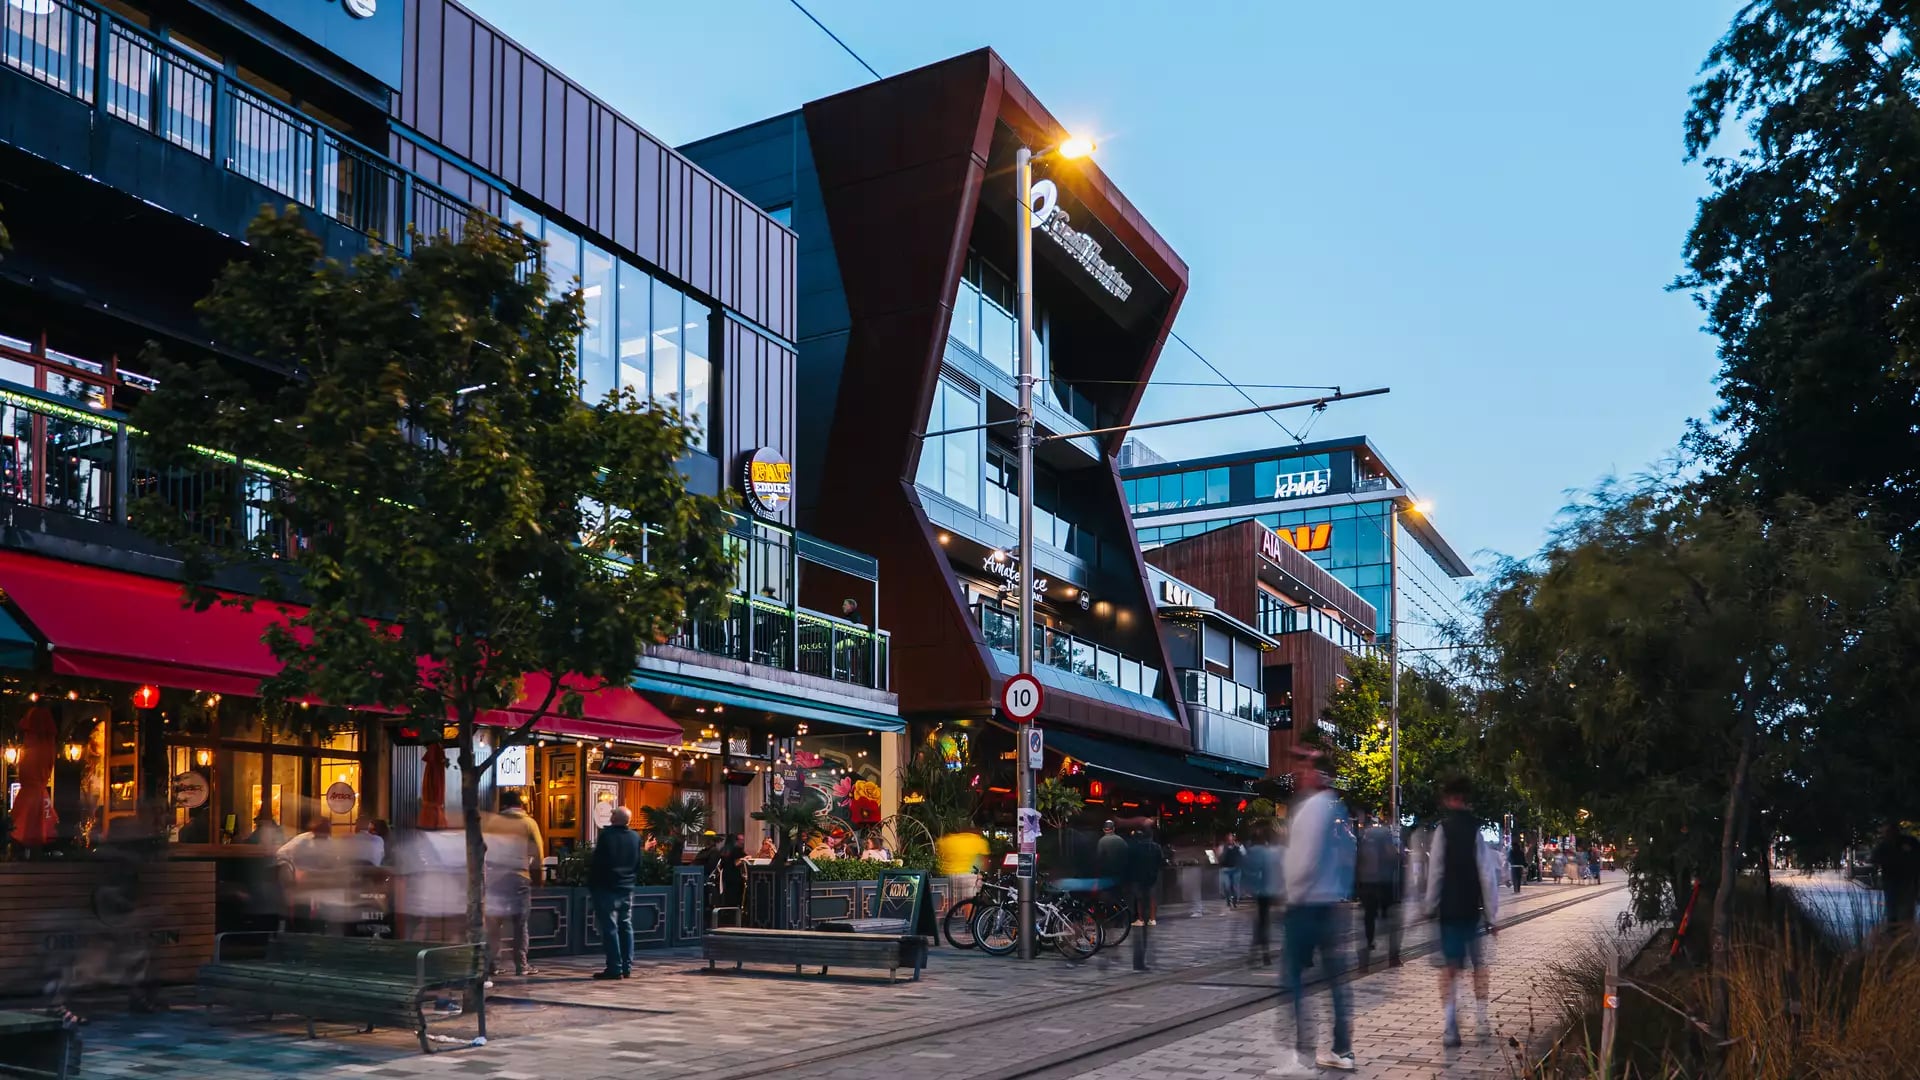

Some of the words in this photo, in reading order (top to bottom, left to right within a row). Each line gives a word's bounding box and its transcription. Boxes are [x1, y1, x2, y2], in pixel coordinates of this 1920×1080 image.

[752, 462, 791, 483] FAT
[1274, 478, 1328, 499] KPMG
[1263, 531, 1281, 562] AIA
[1013, 689, 1031, 707] 10
[1266, 709, 1290, 719] RAFT
[501, 757, 521, 775] KONG
[890, 883, 910, 897] KONG
